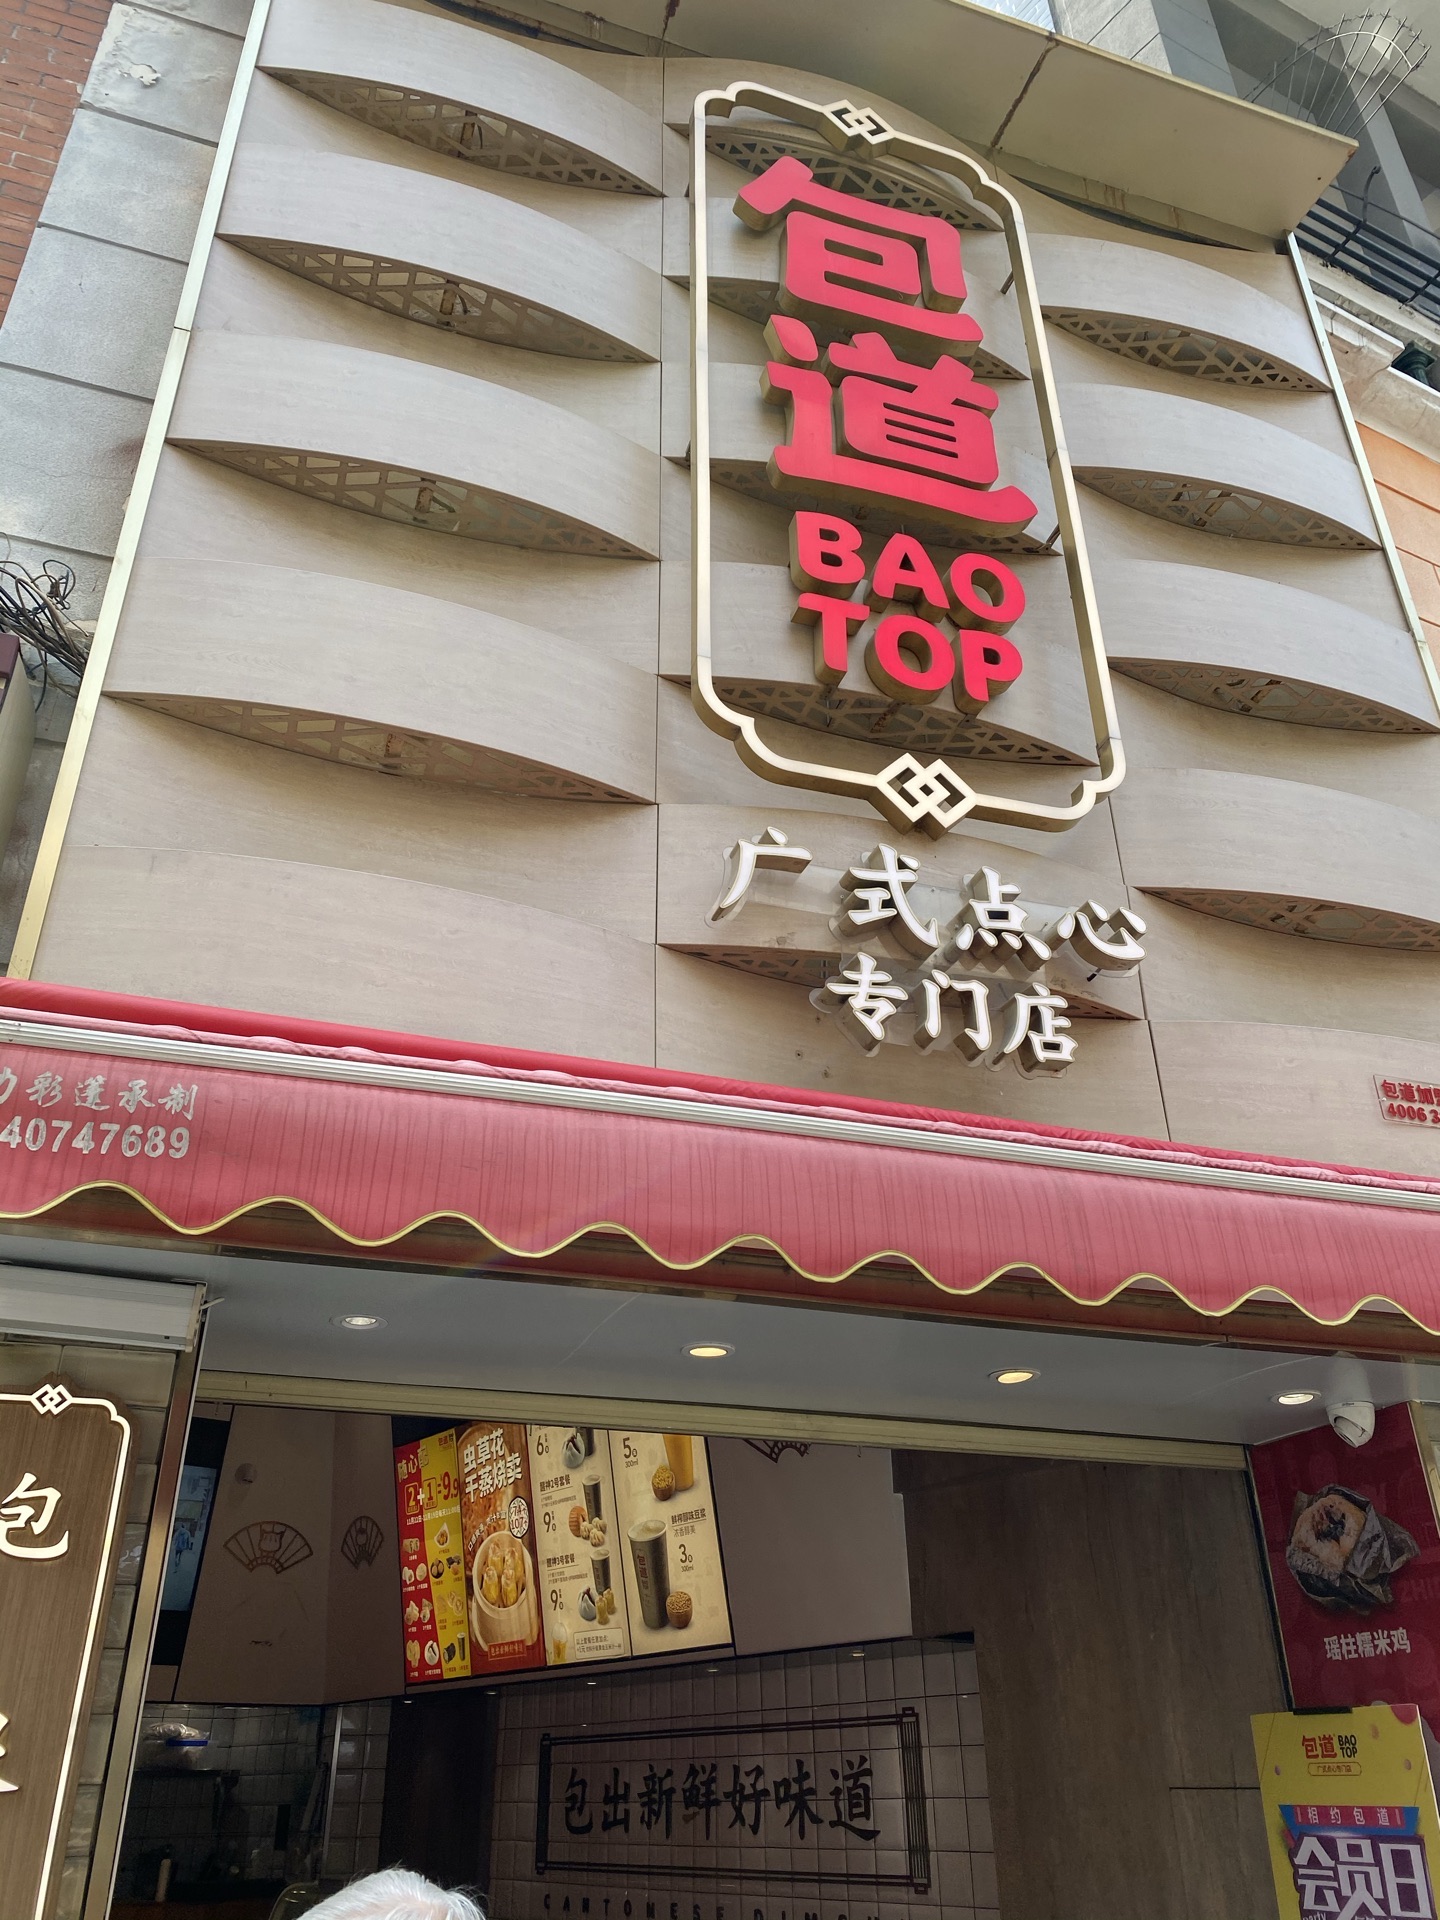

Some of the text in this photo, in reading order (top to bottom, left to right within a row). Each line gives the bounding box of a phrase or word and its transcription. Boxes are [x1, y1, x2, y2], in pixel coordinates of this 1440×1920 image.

[736, 154, 1039, 528] 包道
[793, 510, 1027, 623] BAO
[796, 591, 1024, 704] TOP
[711, 826, 1148, 962] 广式点心
[826, 951, 1079, 1064] 专门店
[1387, 1102, 1427, 1122] 4006
[0, 1115, 191, 1159] 40747689
[463, 1427, 505, 1474] 虫草花
[465, 1452, 522, 1503] 干蒸烧卖
[1323, 1626, 1412, 1661] 瑶柱糯米鸡
[1302, 1734, 1338, 1759] 包道
[1338, 1734, 1357, 1747] BAO
[1340, 1746, 1358, 1758] TOP
[564, 1754, 882, 1842] 包出新鲜好味道
[1307, 1806, 1390, 1826] 相约包道
[1293, 1836, 1433, 1920] 会员日
[543, 1893, 725, 1920] CANTONESE
